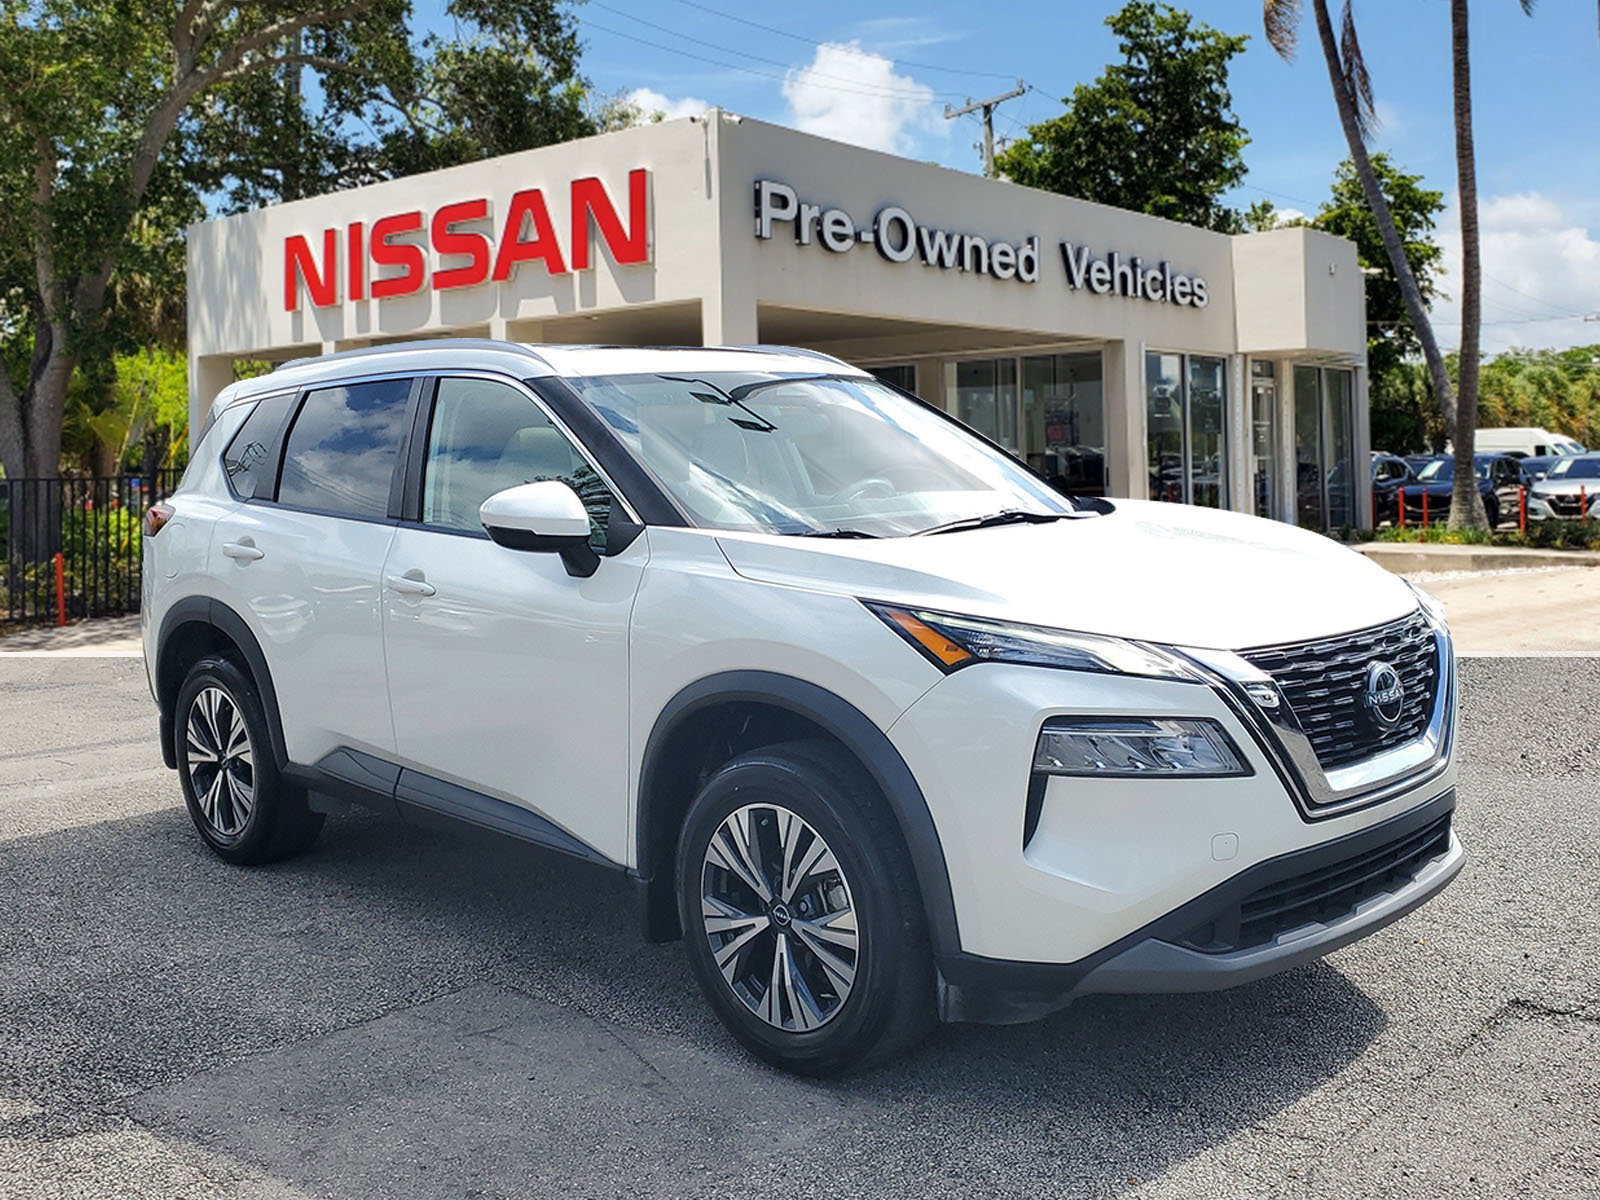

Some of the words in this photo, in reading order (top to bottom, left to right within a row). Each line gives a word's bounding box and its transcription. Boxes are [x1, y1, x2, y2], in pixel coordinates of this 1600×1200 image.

[284, 168, 648, 312] NISSAN
[755, 180, 1040, 283] Pre-Owned
[1061, 242, 1209, 308] Vehicles
